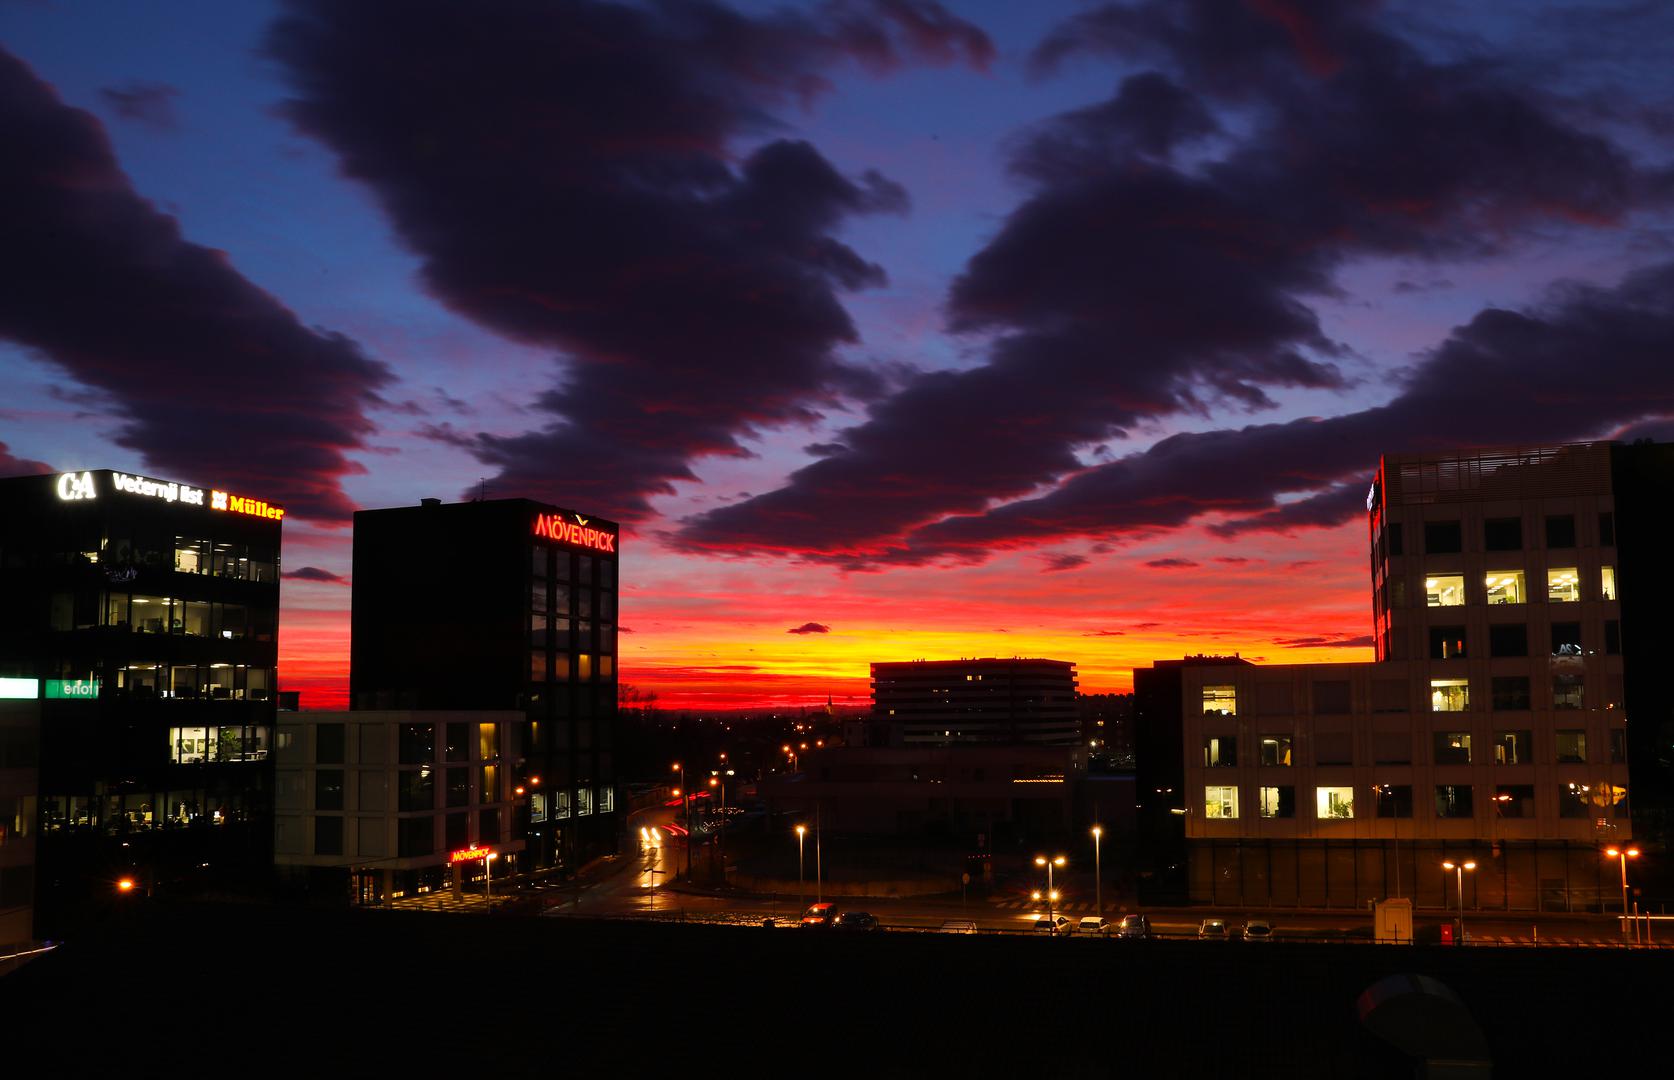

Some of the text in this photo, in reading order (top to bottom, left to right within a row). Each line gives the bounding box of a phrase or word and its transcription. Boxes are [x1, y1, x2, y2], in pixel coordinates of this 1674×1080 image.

[112, 472, 203, 505] Večernji list
[230, 495, 284, 520] Müller
[535, 513, 614, 552] MÖVENPICK
